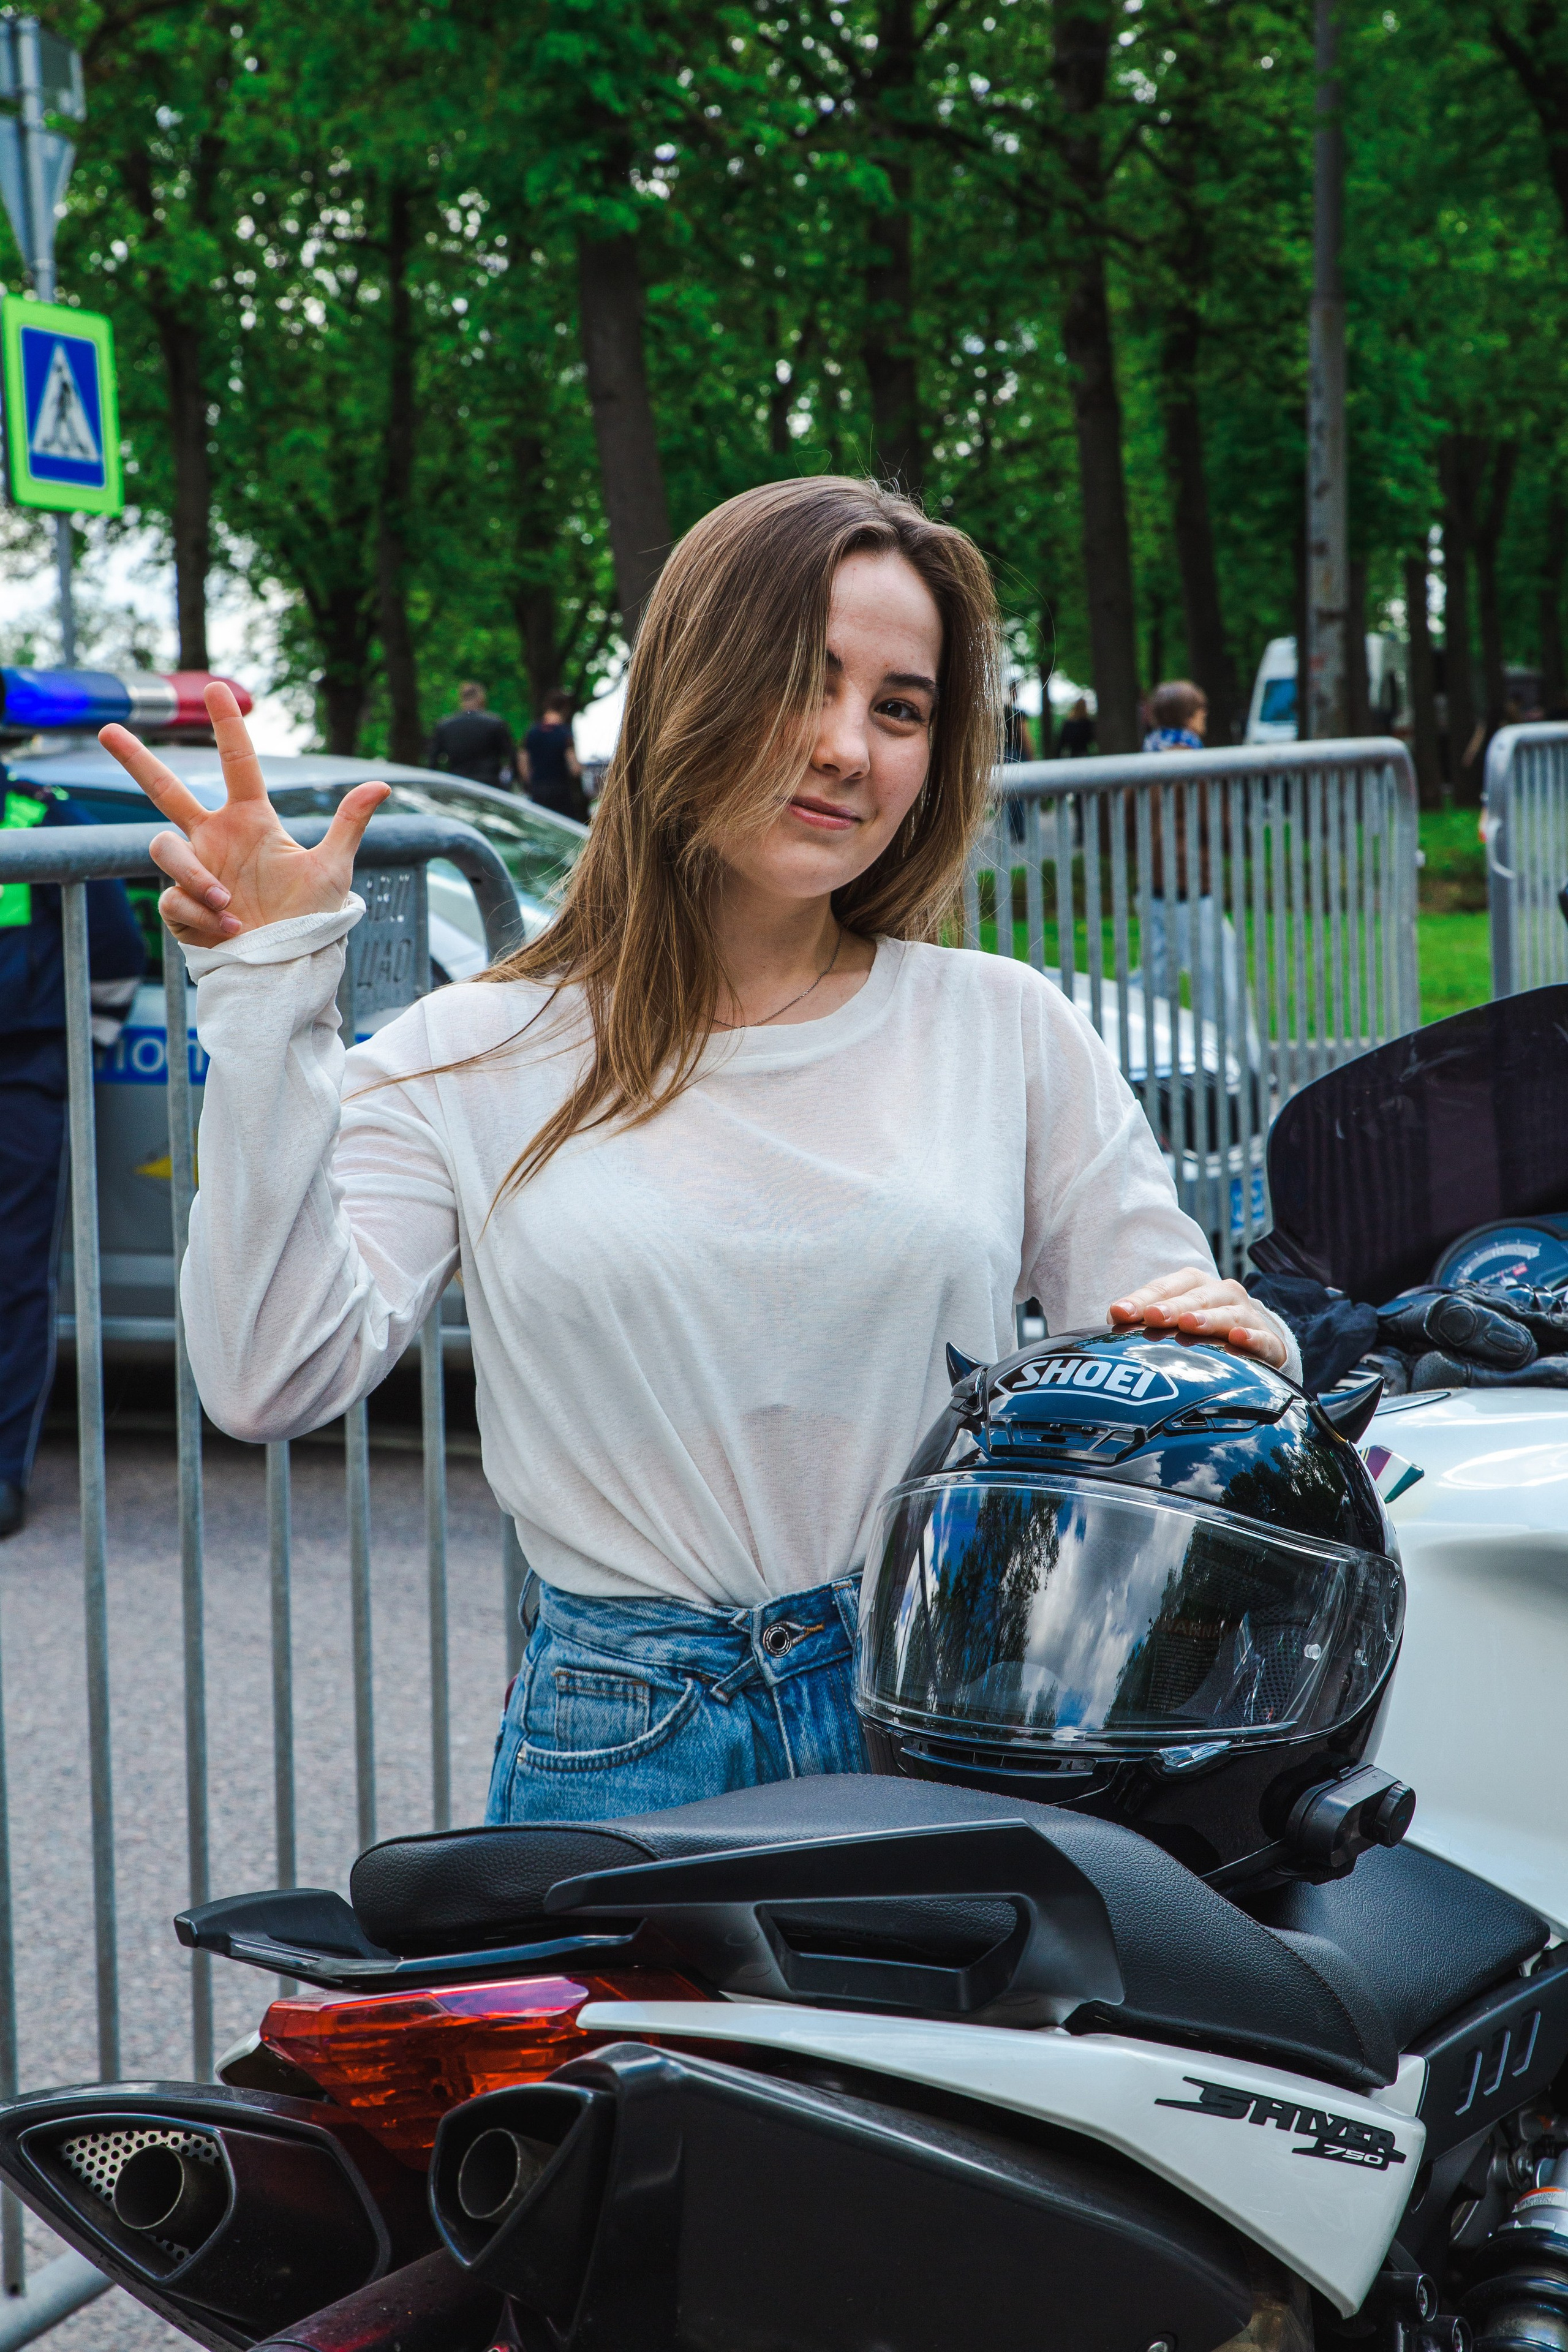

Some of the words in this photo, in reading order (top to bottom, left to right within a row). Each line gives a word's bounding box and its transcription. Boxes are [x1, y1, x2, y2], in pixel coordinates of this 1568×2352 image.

[1012, 1359, 1157, 1398] SHOEI
[1155, 2076, 1407, 2164] SHIVER
[1324, 2144, 1384, 2165] 750
